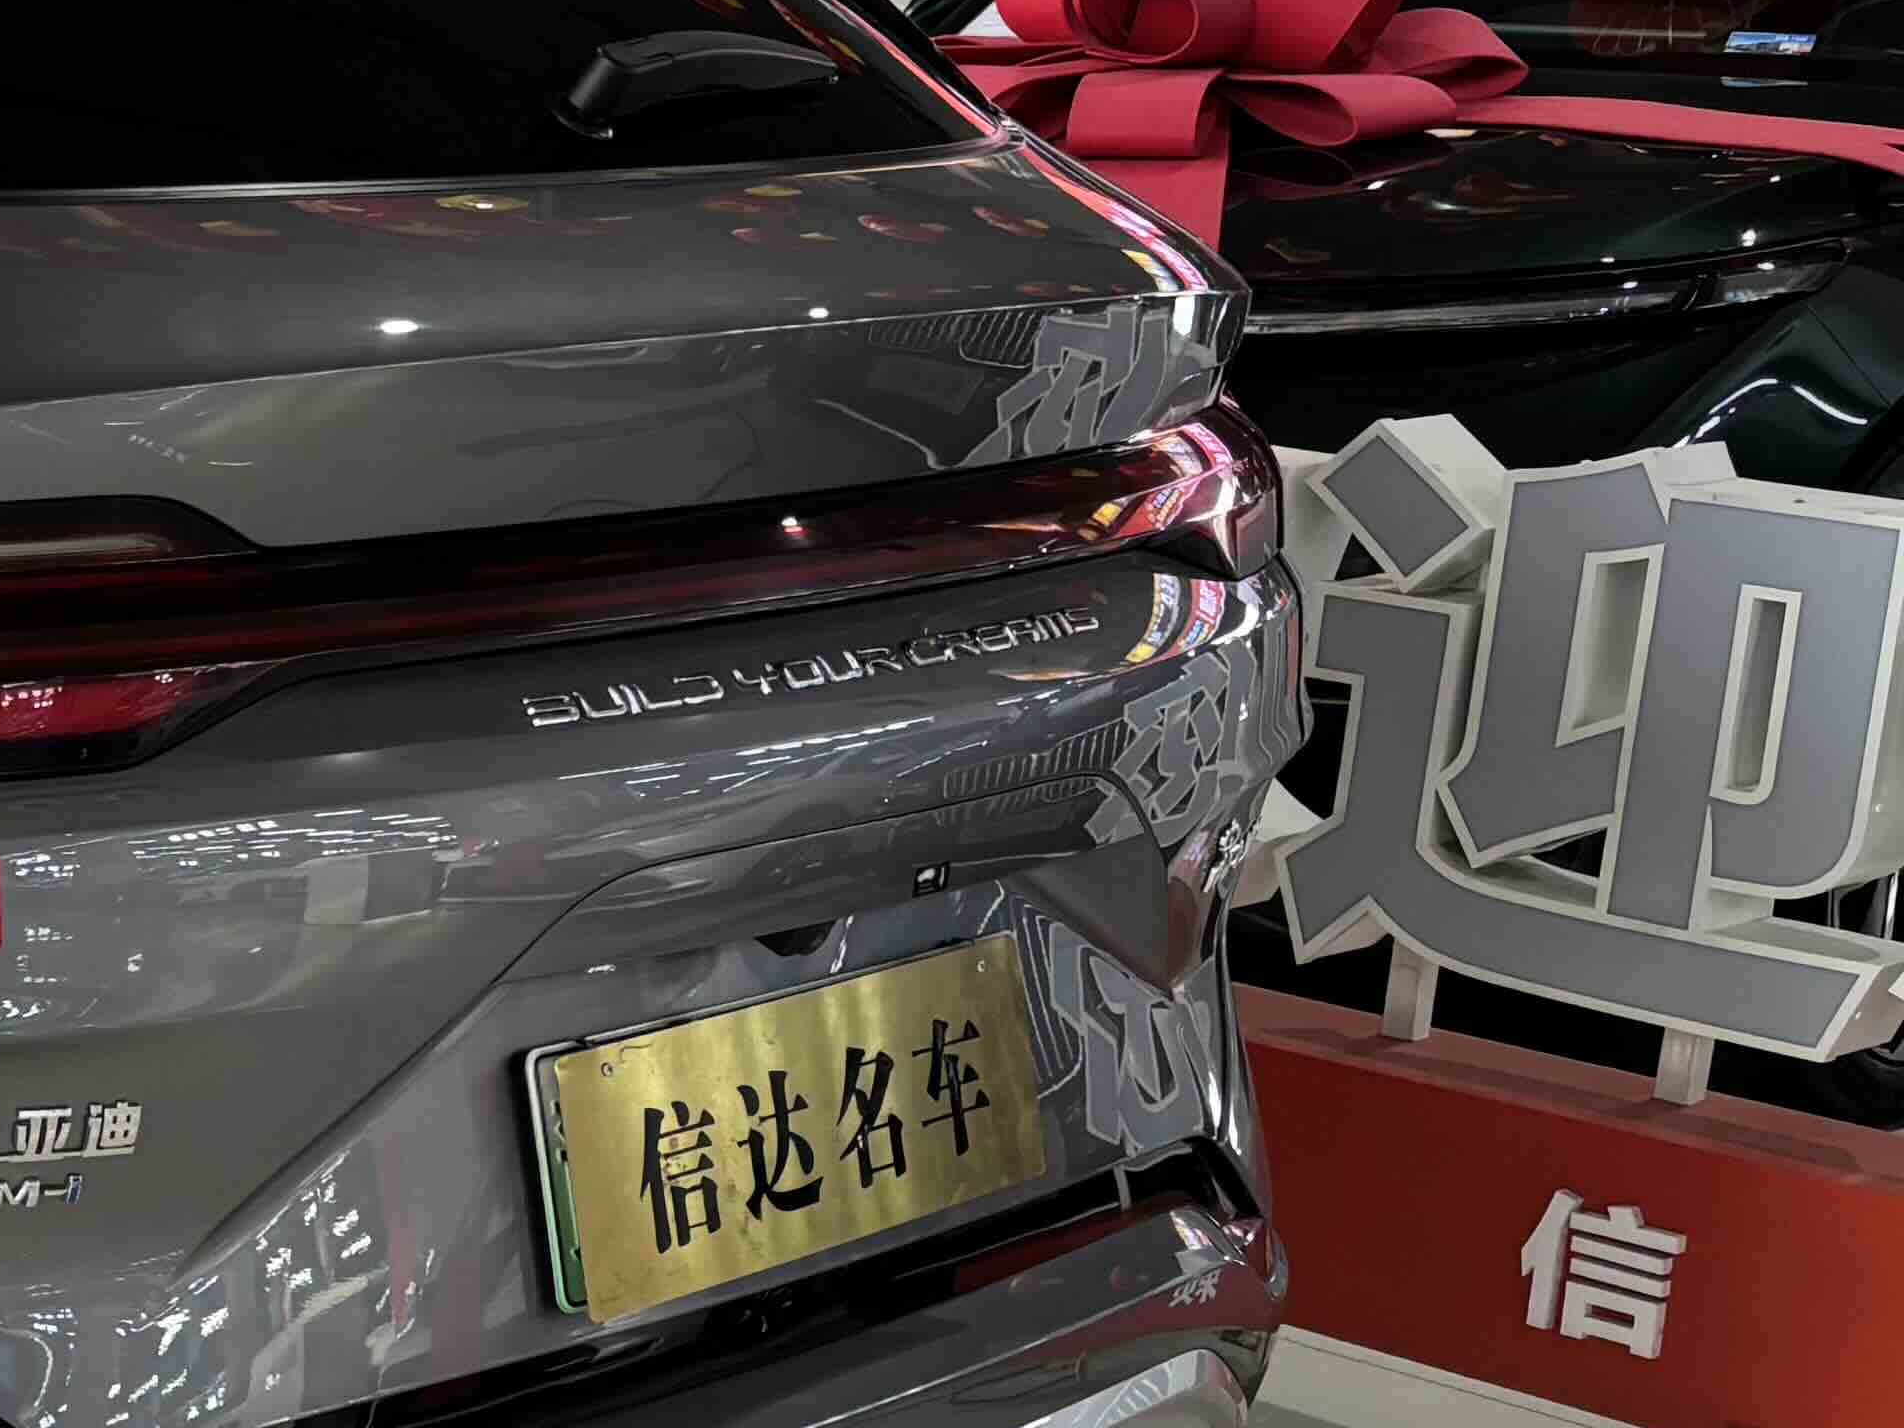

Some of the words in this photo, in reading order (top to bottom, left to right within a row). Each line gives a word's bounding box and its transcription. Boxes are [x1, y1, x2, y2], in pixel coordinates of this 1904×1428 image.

[520, 673, 726, 728] BUILD
[731, 644, 904, 698] YOUR
[903, 606, 1100, 668] DREAMS
[1274, 412, 1904, 1062] 迎
[638, 1014, 992, 1259] 信达名车
[1519, 1186, 1689, 1361] 信
